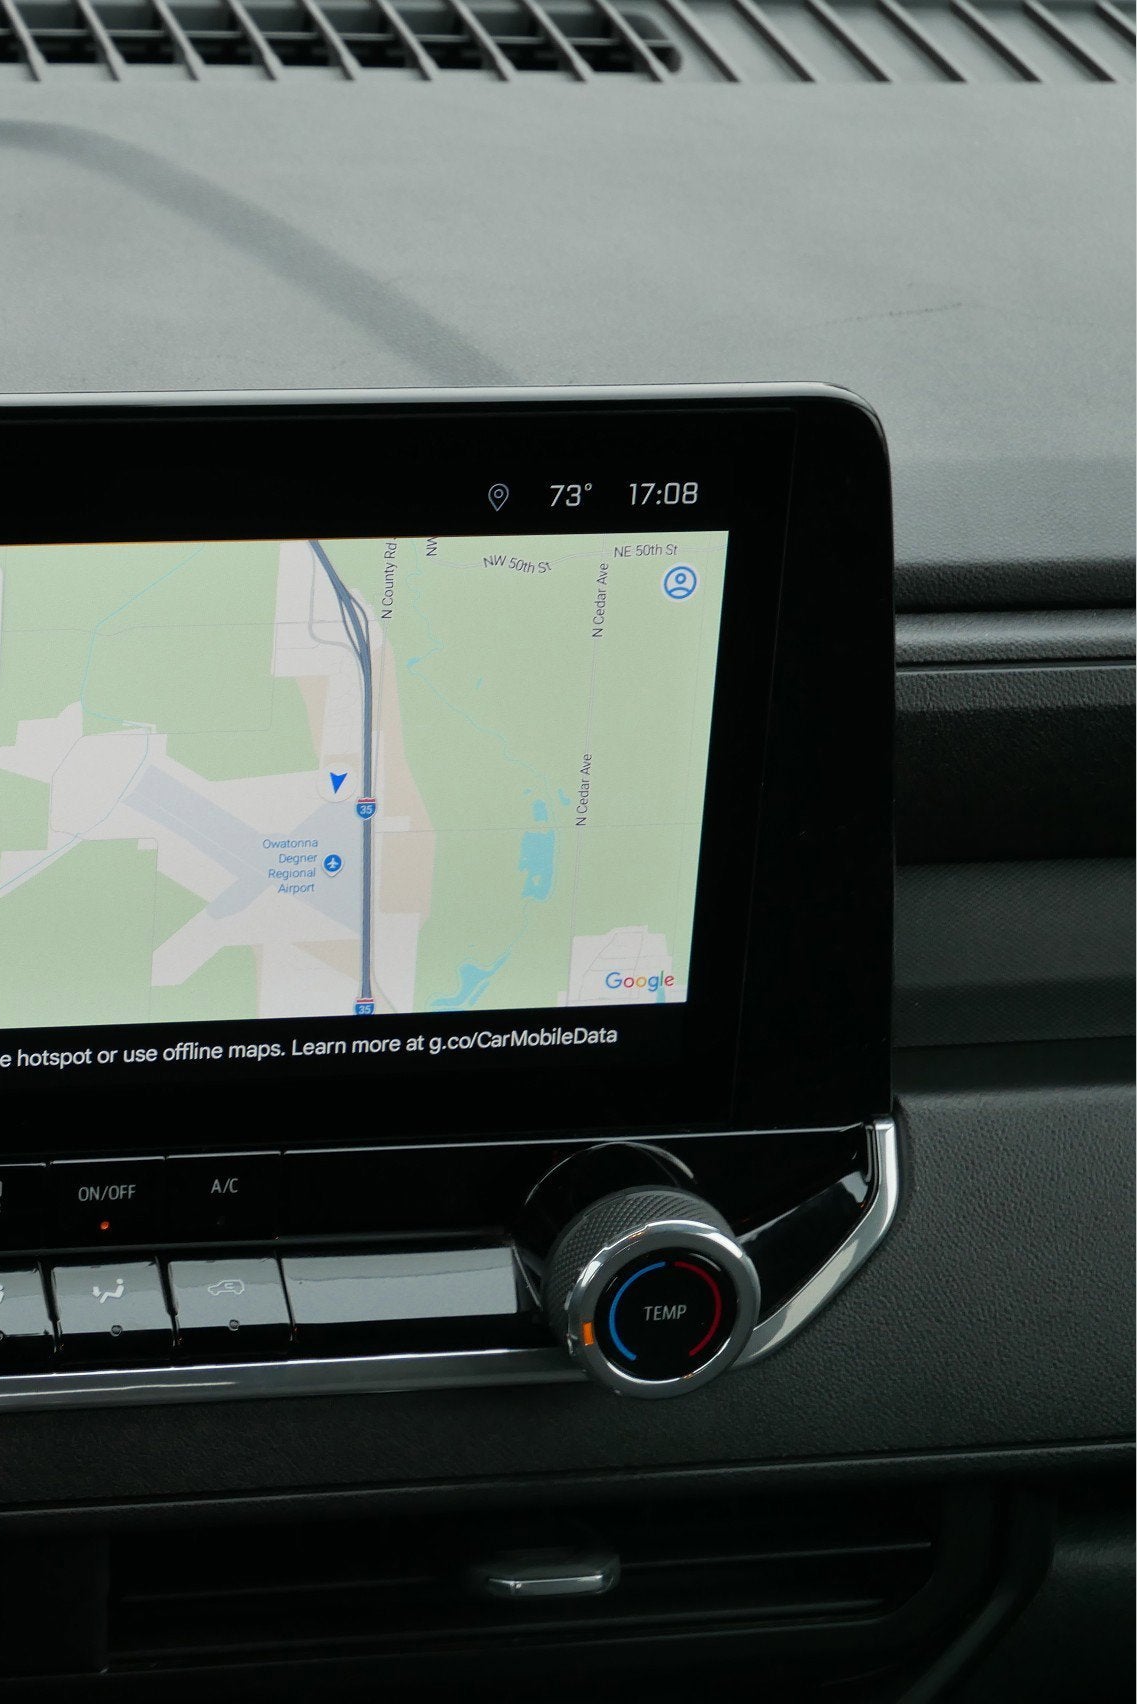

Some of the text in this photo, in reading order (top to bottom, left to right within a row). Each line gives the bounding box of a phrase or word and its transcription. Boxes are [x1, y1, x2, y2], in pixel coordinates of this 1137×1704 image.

[629, 482, 699, 506] 17:08
[614, 543, 679, 558] NE 50th St
[483, 554, 552, 574] NW 50th St
[381, 542, 398, 619] N County Rd
[592, 562, 610, 638] N Cedar Ave
[575, 753, 593, 826] N Cedar Ave
[359, 805, 373, 815] 35
[262, 838, 319, 850] Owatonna
[278, 853, 318, 866] Degner
[268, 867, 316, 881] Regional
[277, 883, 315, 895] Airport
[605, 970, 675, 992] Google
[358, 1004, 372, 1015] 35
[17, 1047, 93, 1071] hotspot
[96, 1050, 118, 1064] or
[123, 1048, 158, 1063] use
[163, 1041, 224, 1061] offline
[228, 1042, 286, 1062] maps.
[291, 1038, 347, 1057] Learn
[351, 1036, 402, 1054] more
[405, 1034, 425, 1052] at
[428, 1026, 618, 1055] g.co/CarMobileData
[77, 1184, 137, 1202] ON/OFF
[210, 1178, 239, 1194] A/C
[644, 1304, 688, 1322] TEMP
